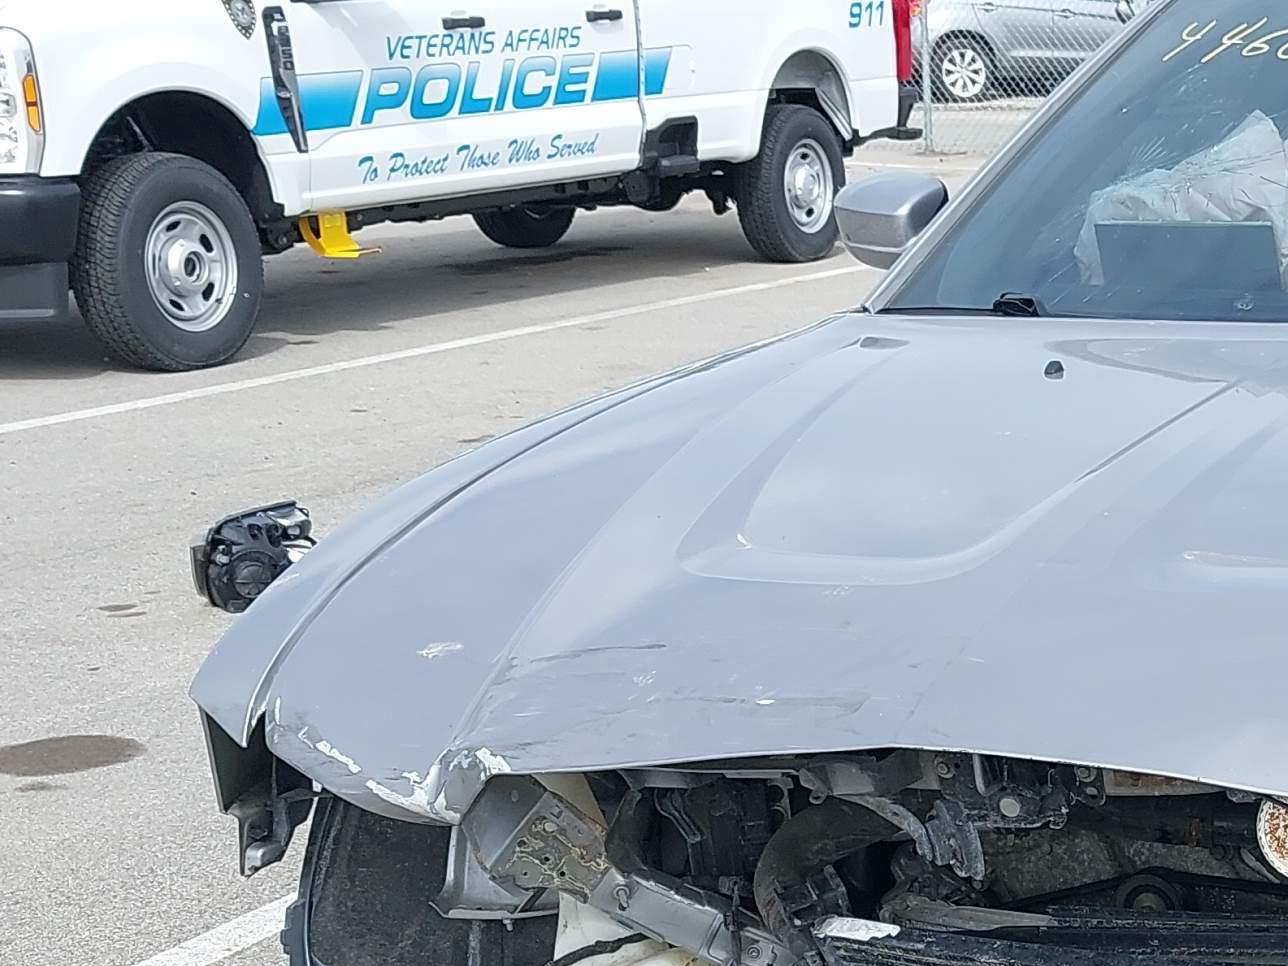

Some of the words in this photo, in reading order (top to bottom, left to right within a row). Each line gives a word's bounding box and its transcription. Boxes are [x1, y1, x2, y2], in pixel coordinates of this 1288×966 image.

[848, 1, 885, 28] 911
[386, 31, 496, 61] VETERANS
[501, 26, 582, 53] AFFAIRS
[360, 53, 595, 125] POLICE
[358, 155, 379, 184] To
[387, 152, 449, 182] Protect
[456, 144, 500, 172] Those
[507, 139, 541, 164] Who
[550, 132, 600, 160] Served
